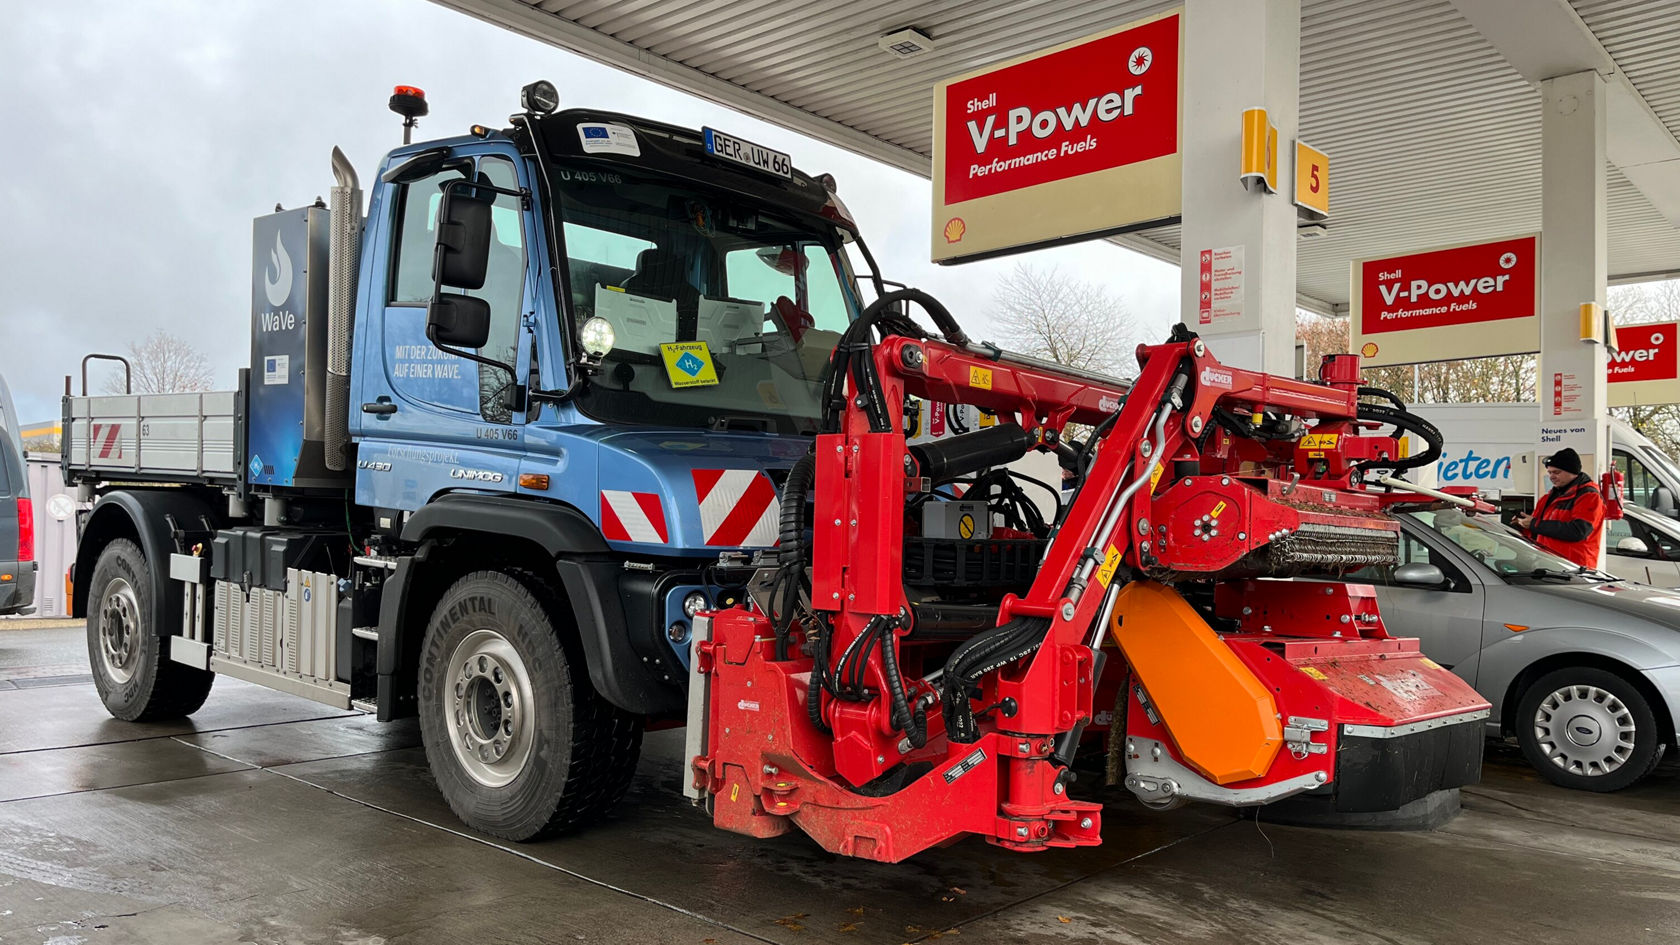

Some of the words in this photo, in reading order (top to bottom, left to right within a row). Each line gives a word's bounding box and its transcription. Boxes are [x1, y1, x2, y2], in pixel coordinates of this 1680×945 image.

[966, 92, 997, 114] Shell
[966, 84, 1143, 155] V-Power
[713, 133, 743, 161] GER
[751, 143, 770, 169] UW
[772, 154, 790, 175] 66
[969, 147, 1057, 179] Performance
[1060, 134, 1098, 157] Fuels
[560, 170, 572, 181] U
[574, 172, 597, 182] 405
[599, 173, 622, 184] V66
[1309, 163, 1320, 194] 5
[1378, 269, 1402, 281] Shell
[1378, 274, 1510, 306] V-Power
[1380, 305, 1448, 320] Performance
[1450, 300, 1477, 312] Fuels
[261, 310, 295, 332] WaVe
[396, 345, 410, 360] MIT
[411, 346, 429, 360] DER
[394, 363, 409, 378] AUF
[410, 364, 432, 378] EINER
[435, 364, 461, 379] WAVE.
[1614, 365, 1635, 374] Fuels
[142, 424, 149, 437] 63
[476, 427, 482, 439] U
[484, 429, 499, 440] 405
[501, 429, 518, 440] V66
[450, 468, 503, 483] UNIMOG
[1437, 449, 1511, 482] ieten
[422, 596, 497, 698] CONTINENTAL
